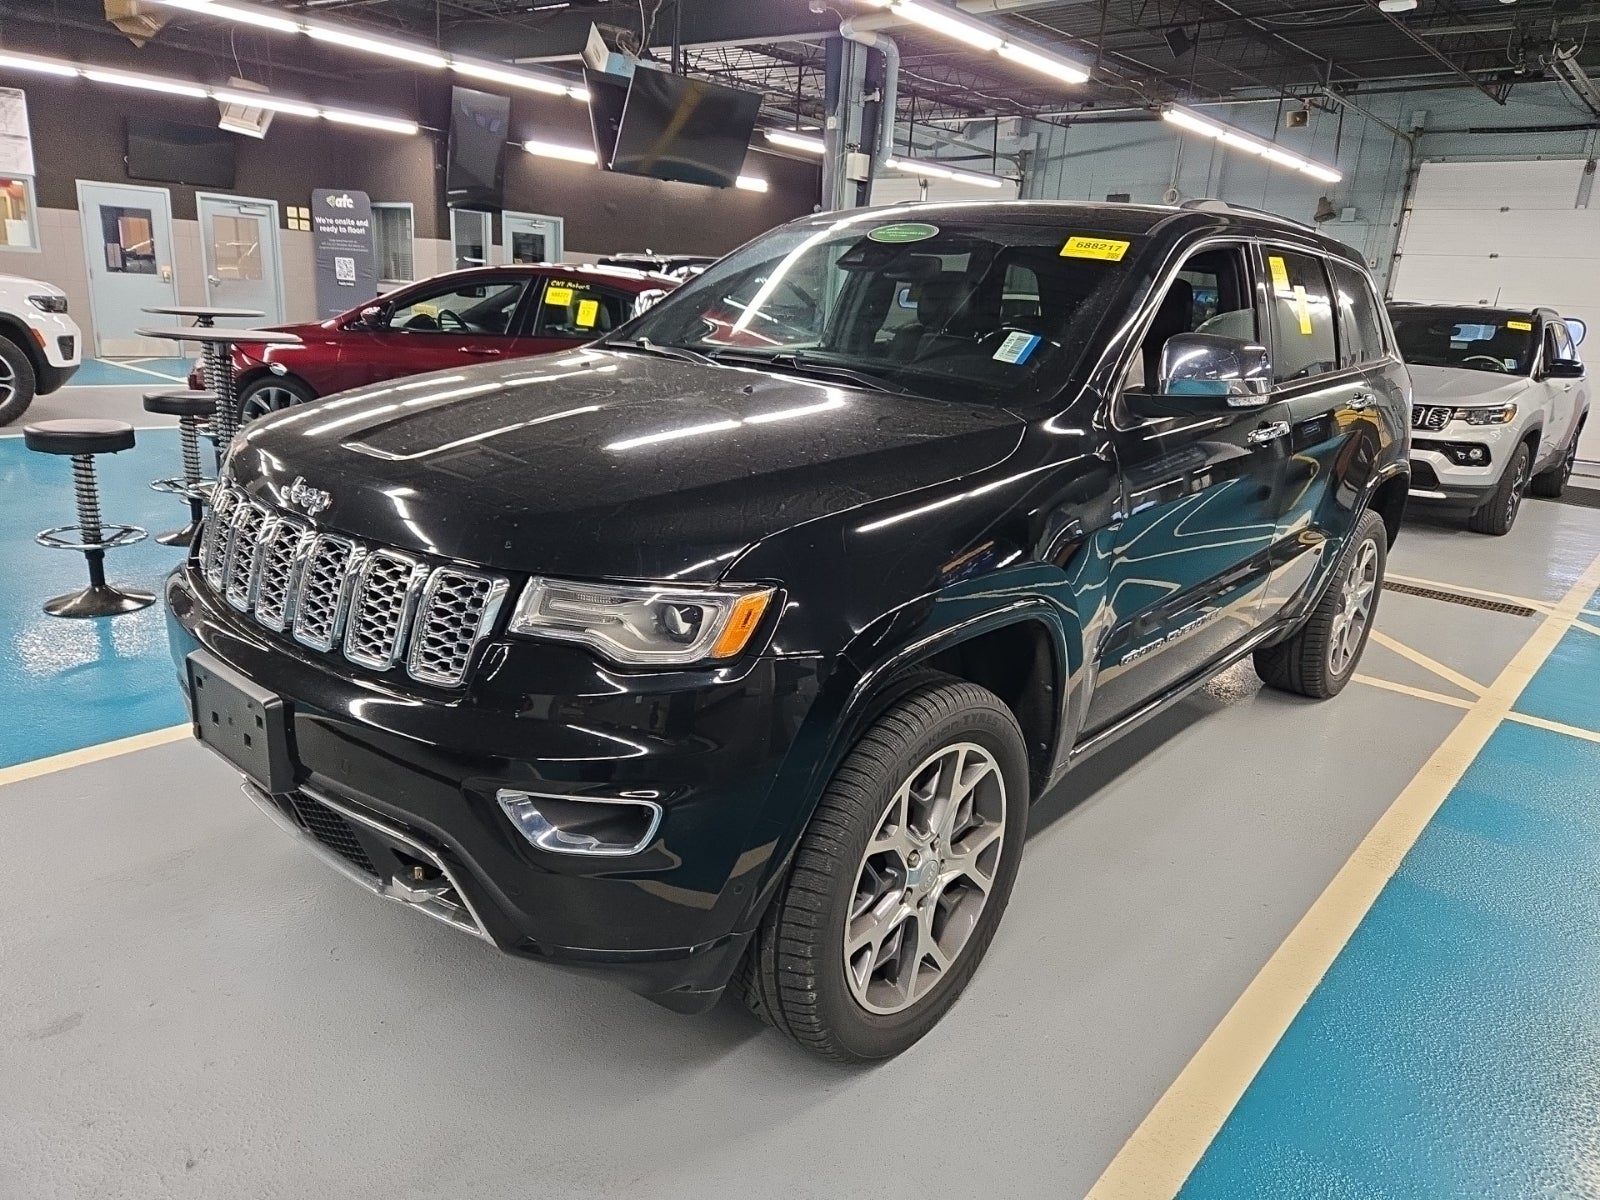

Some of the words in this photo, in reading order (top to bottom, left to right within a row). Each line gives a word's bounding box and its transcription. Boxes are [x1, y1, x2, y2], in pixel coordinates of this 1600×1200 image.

[335, 194, 354, 209] afc
[315, 216, 334, 225] We're
[334, 218, 355, 226] onsite
[356, 219, 369, 227] and
[319, 226, 338, 234] ready
[347, 227, 366, 235] floor!
[1076, 241, 1123, 252] 688217
[280, 475, 332, 517] Jeep
[962, 713, 1001, 728] TYRES
